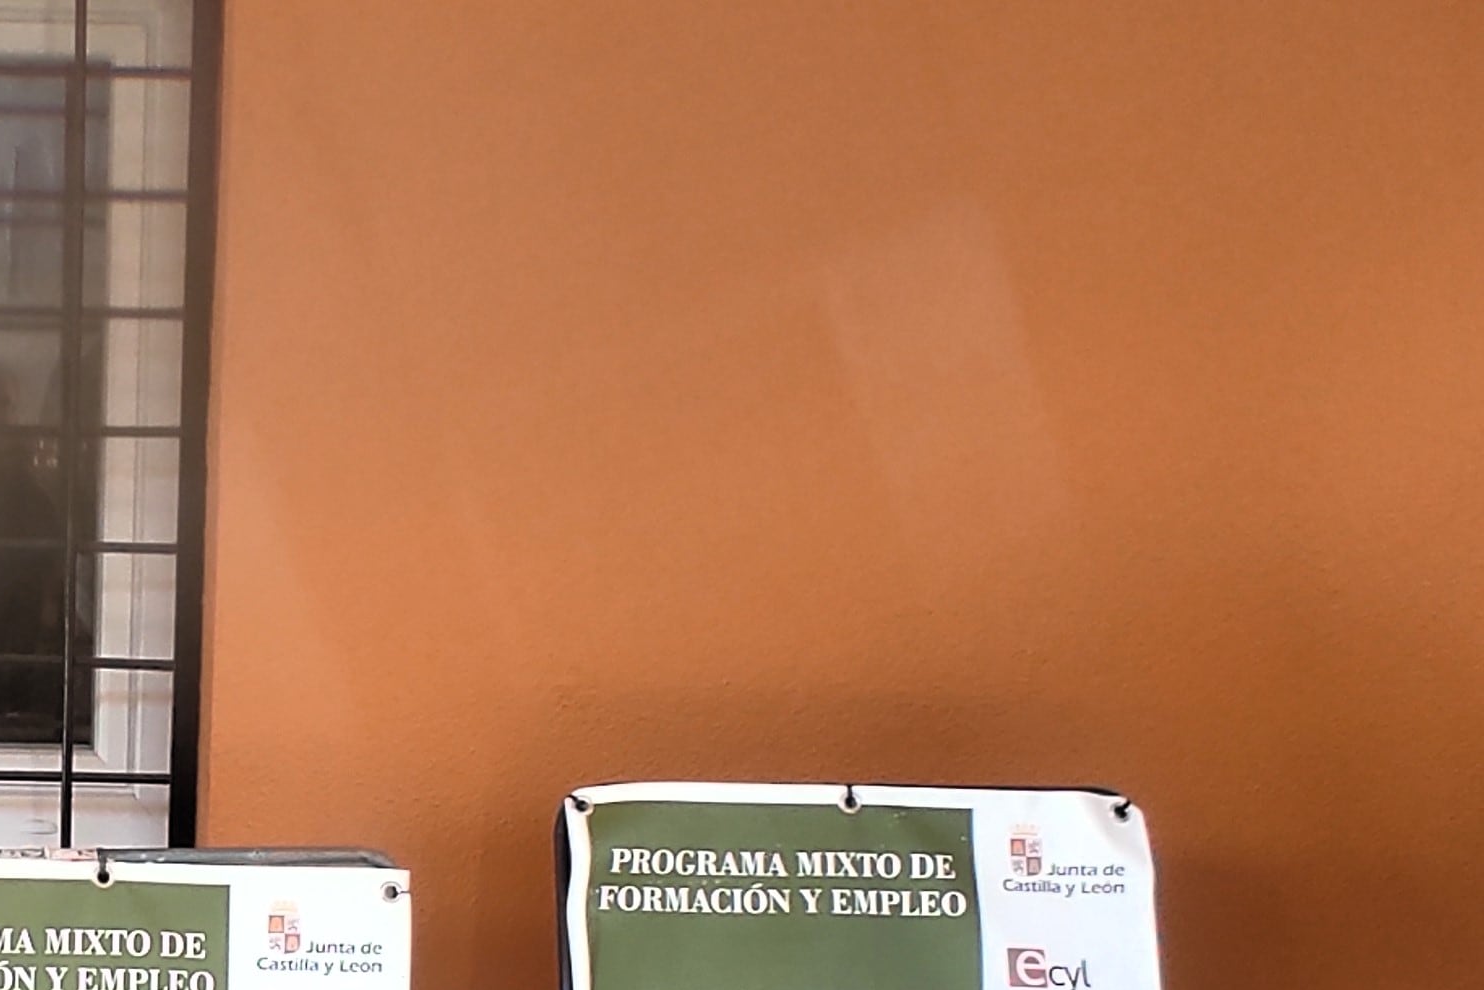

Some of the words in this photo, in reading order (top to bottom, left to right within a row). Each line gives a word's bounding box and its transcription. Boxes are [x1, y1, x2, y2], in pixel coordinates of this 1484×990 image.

[610, 848, 788, 880] PROGRAMA
[796, 851, 902, 879] MIXTO
[909, 853, 956, 879] DE
[1047, 863, 1098, 877] Junta
[1103, 864, 1125, 877] de
[1002, 879, 1061, 894] Castilla
[1065, 883, 1076, 898] y
[1081, 881, 1125, 895] León
[598, 882, 791, 915] FORMACIÓN
[799, 888, 822, 914] Y
[831, 888, 967, 917] EMPLEO
[44, 928, 151, 957] MIXTO
[160, 931, 206, 959] DE
[306, 941, 355, 954] Junta
[361, 942, 382, 955] de
[256, 957, 319, 972] Castilla
[324, 961, 334, 976] y
